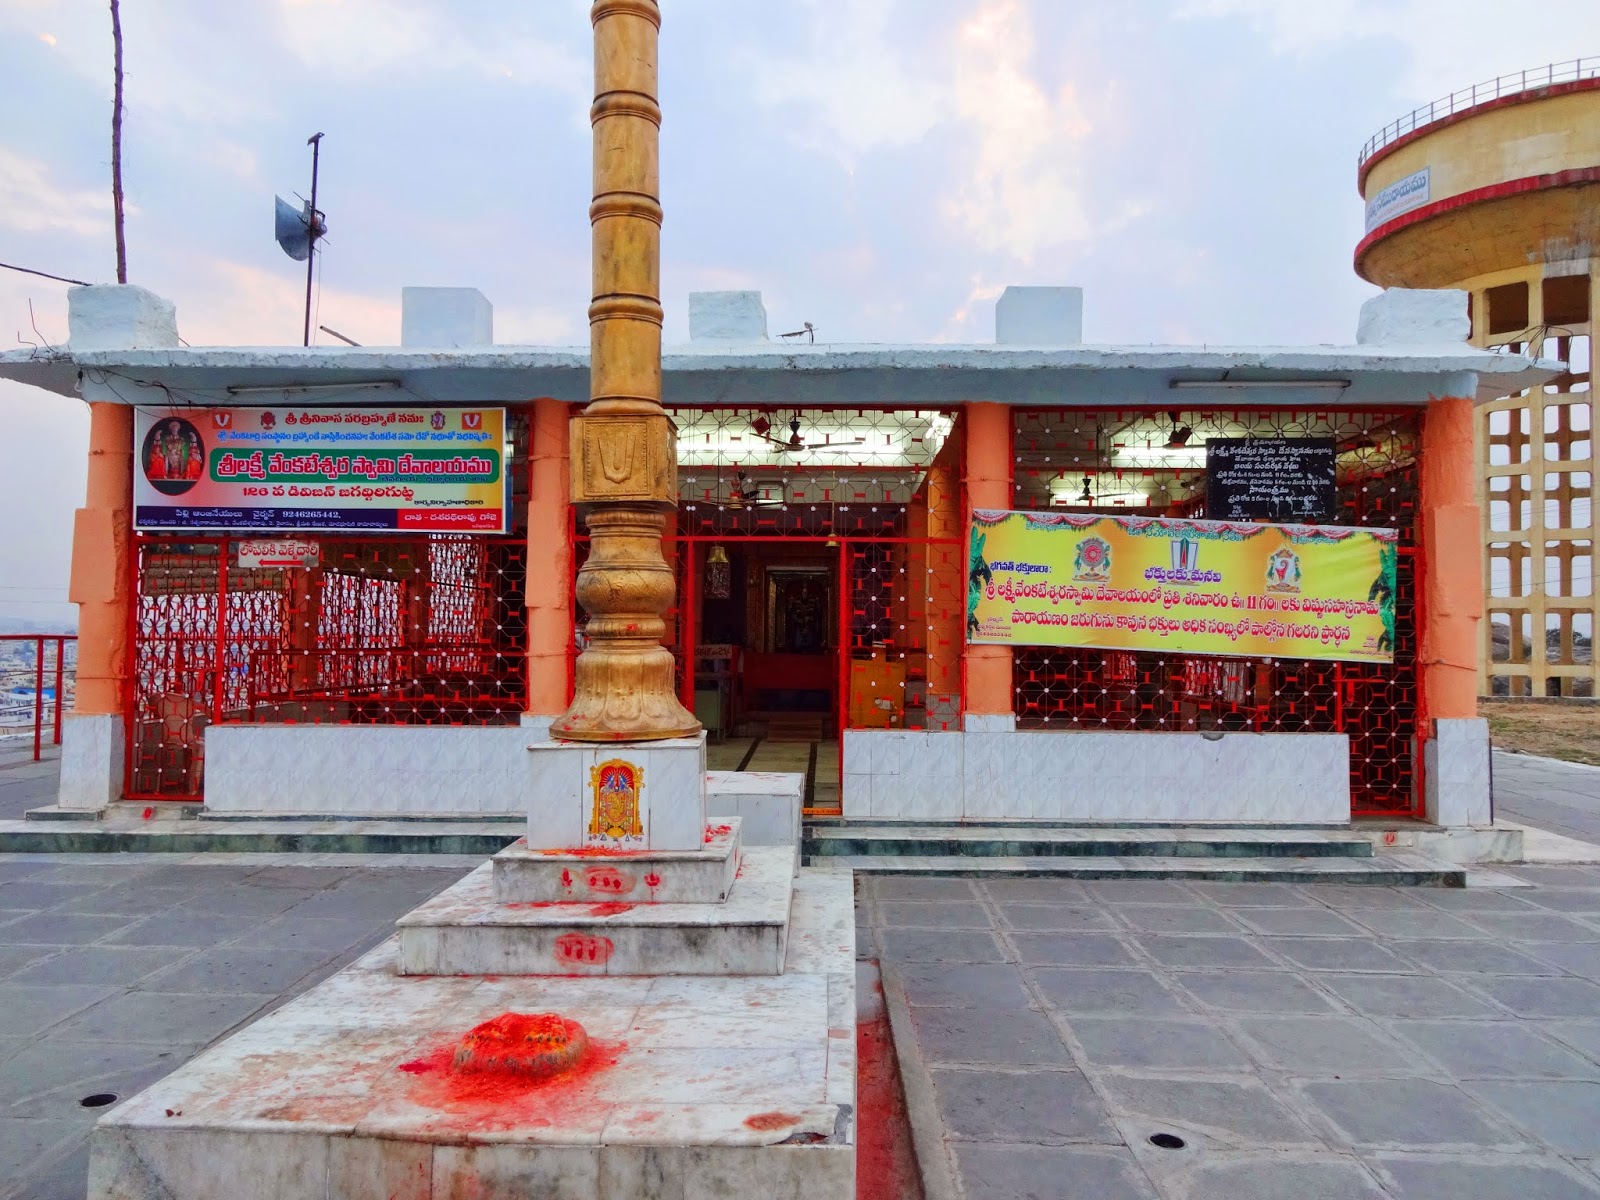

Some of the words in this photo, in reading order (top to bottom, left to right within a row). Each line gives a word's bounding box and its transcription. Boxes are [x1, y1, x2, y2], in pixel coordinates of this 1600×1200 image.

[285, 411, 297, 425] శ్రీ
[300, 411, 342, 425] శ్రీనివాస
[398, 412, 424, 423] నమః
[268, 452, 350, 479] వేంకటేశ్వర
[352, 455, 396, 479] స్వామి
[397, 453, 492, 475] దేవాలయము
[243, 487, 269, 497] 126
[272, 485, 285, 497] వ
[288, 485, 336, 497] డివిజన్
[404, 513, 422, 521] దాత
[240, 542, 277, 556] లోపలికి
[990, 561, 1014, 572] భగవత్
[1144, 566, 1188, 584] భక్తులకు
[1190, 568, 1221, 583] మనవి
[985, 577, 995, 601] శ్రీ
[1096, 583, 1162, 604] దేవాలయంలో
[1163, 589, 1181, 610] ప్రతి
[1182, 591, 1228, 608] శనివారం
[1246, 595, 1257, 610] 11
[1281, 597, 1300, 612] లకు
[1302, 598, 1379, 619] విష్ణుసహస్రనామ
[1011, 608, 1069, 626] పారాయణం
[1070, 611, 1114, 628] జరుగును
[1116, 614, 1146, 633] కావున
[1148, 615, 1180, 637] భక్తులు
[1182, 617, 1207, 635] అధిక
[1208, 618, 1250, 642] సంఖ్యలో
[1287, 623, 1319, 639] గలరని
